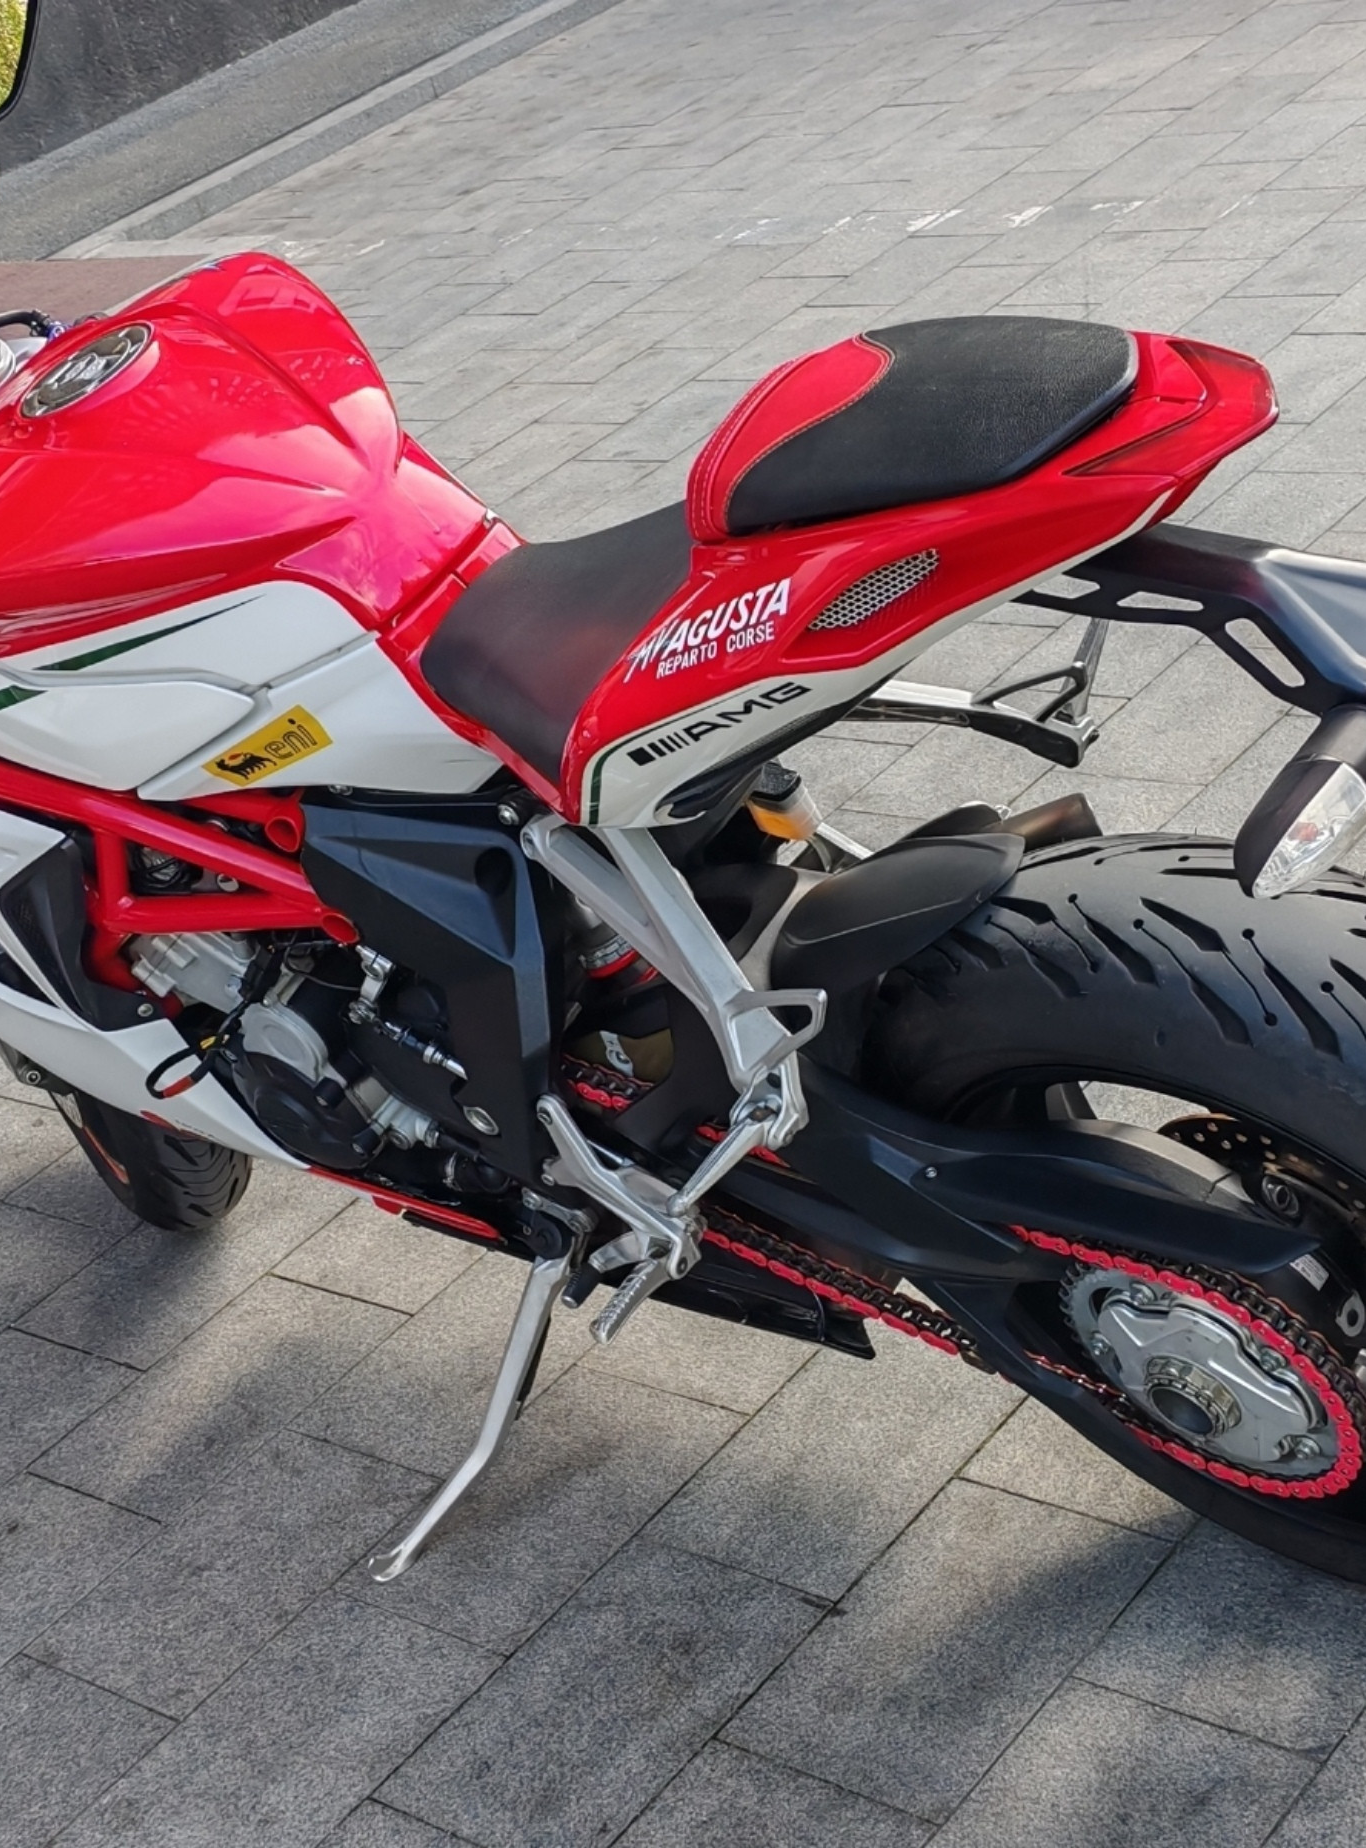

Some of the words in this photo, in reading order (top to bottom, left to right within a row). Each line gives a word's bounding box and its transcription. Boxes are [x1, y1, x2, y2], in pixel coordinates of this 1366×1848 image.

[655, 640, 718, 680] REPARTO
[726, 620, 775, 653] CORSE
[263, 718, 318, 760] eni
[684, 682, 813, 743] AMG
